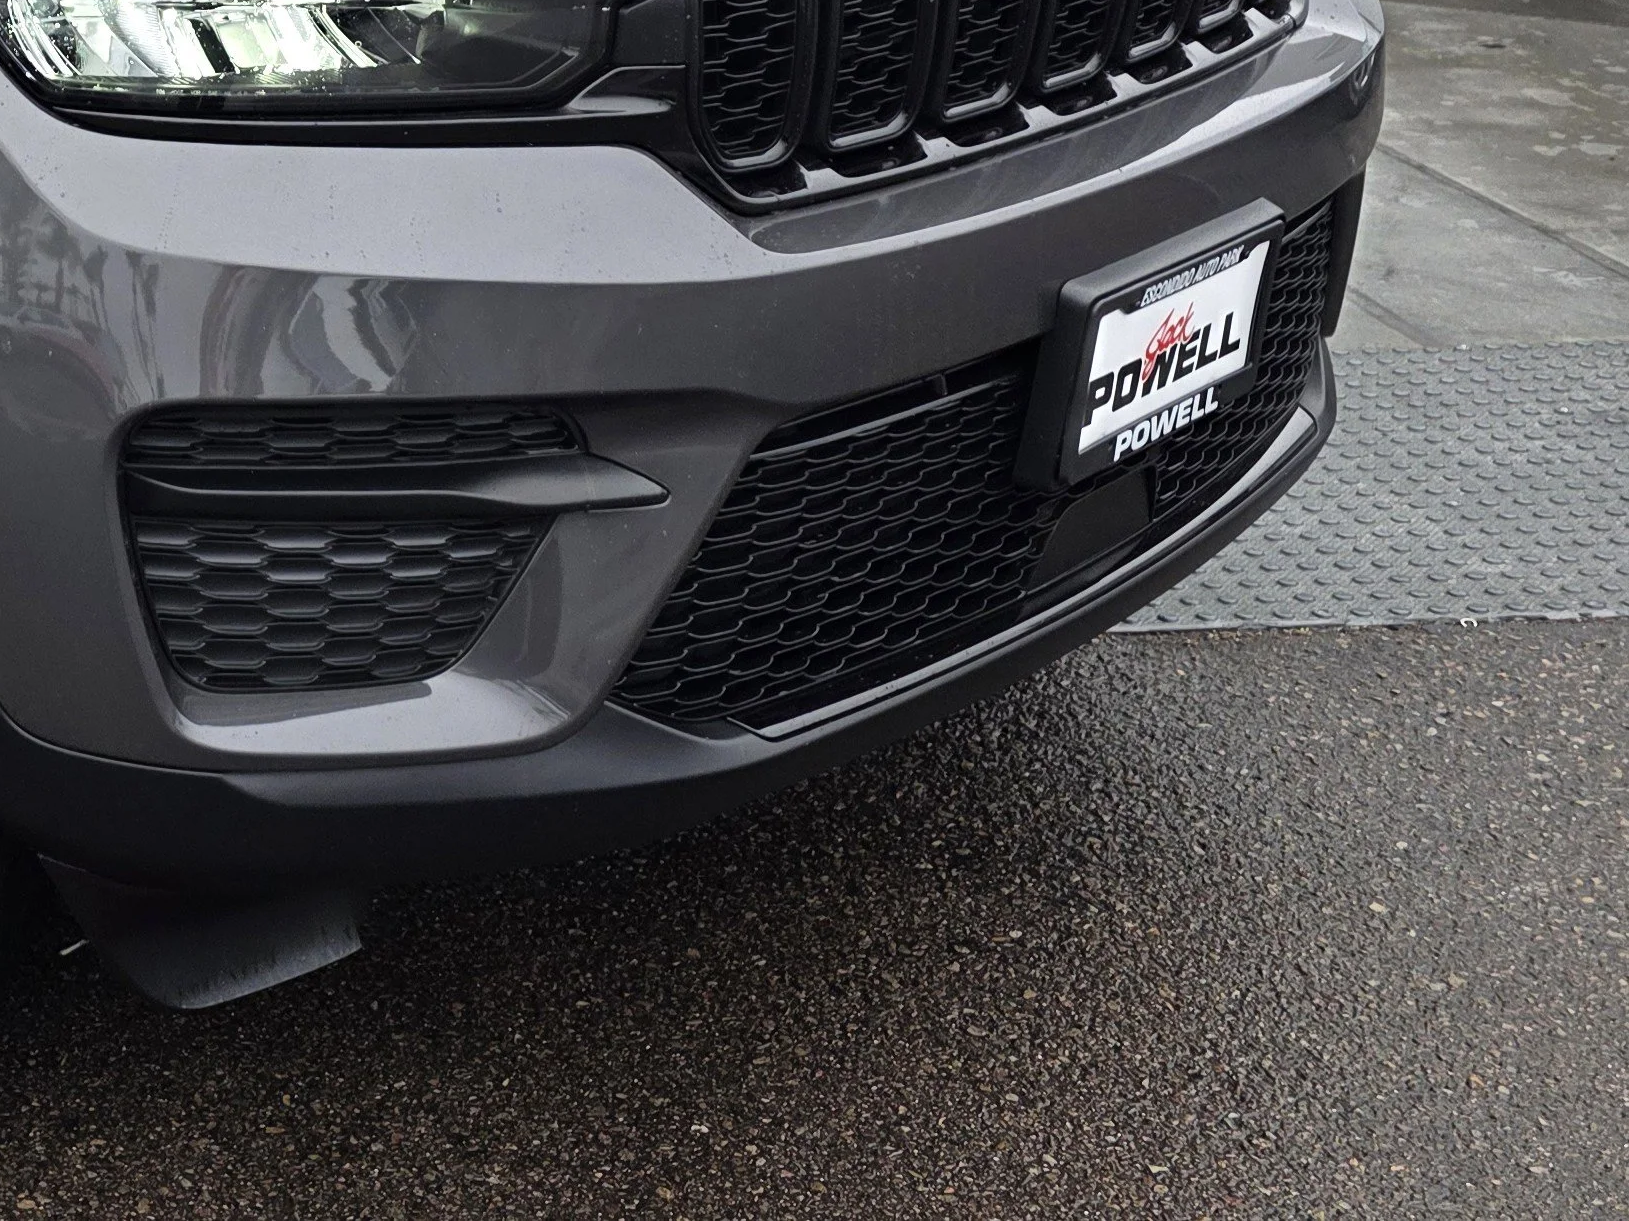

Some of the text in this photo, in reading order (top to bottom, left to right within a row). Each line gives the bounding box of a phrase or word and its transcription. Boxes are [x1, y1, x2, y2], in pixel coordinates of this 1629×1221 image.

[1140, 244, 1245, 307] ESCONDIDO AUTO PARK
[1082, 311, 1241, 428] POWELL
[1141, 301, 1195, 382] Jack
[1113, 386, 1219, 463] POWELL
